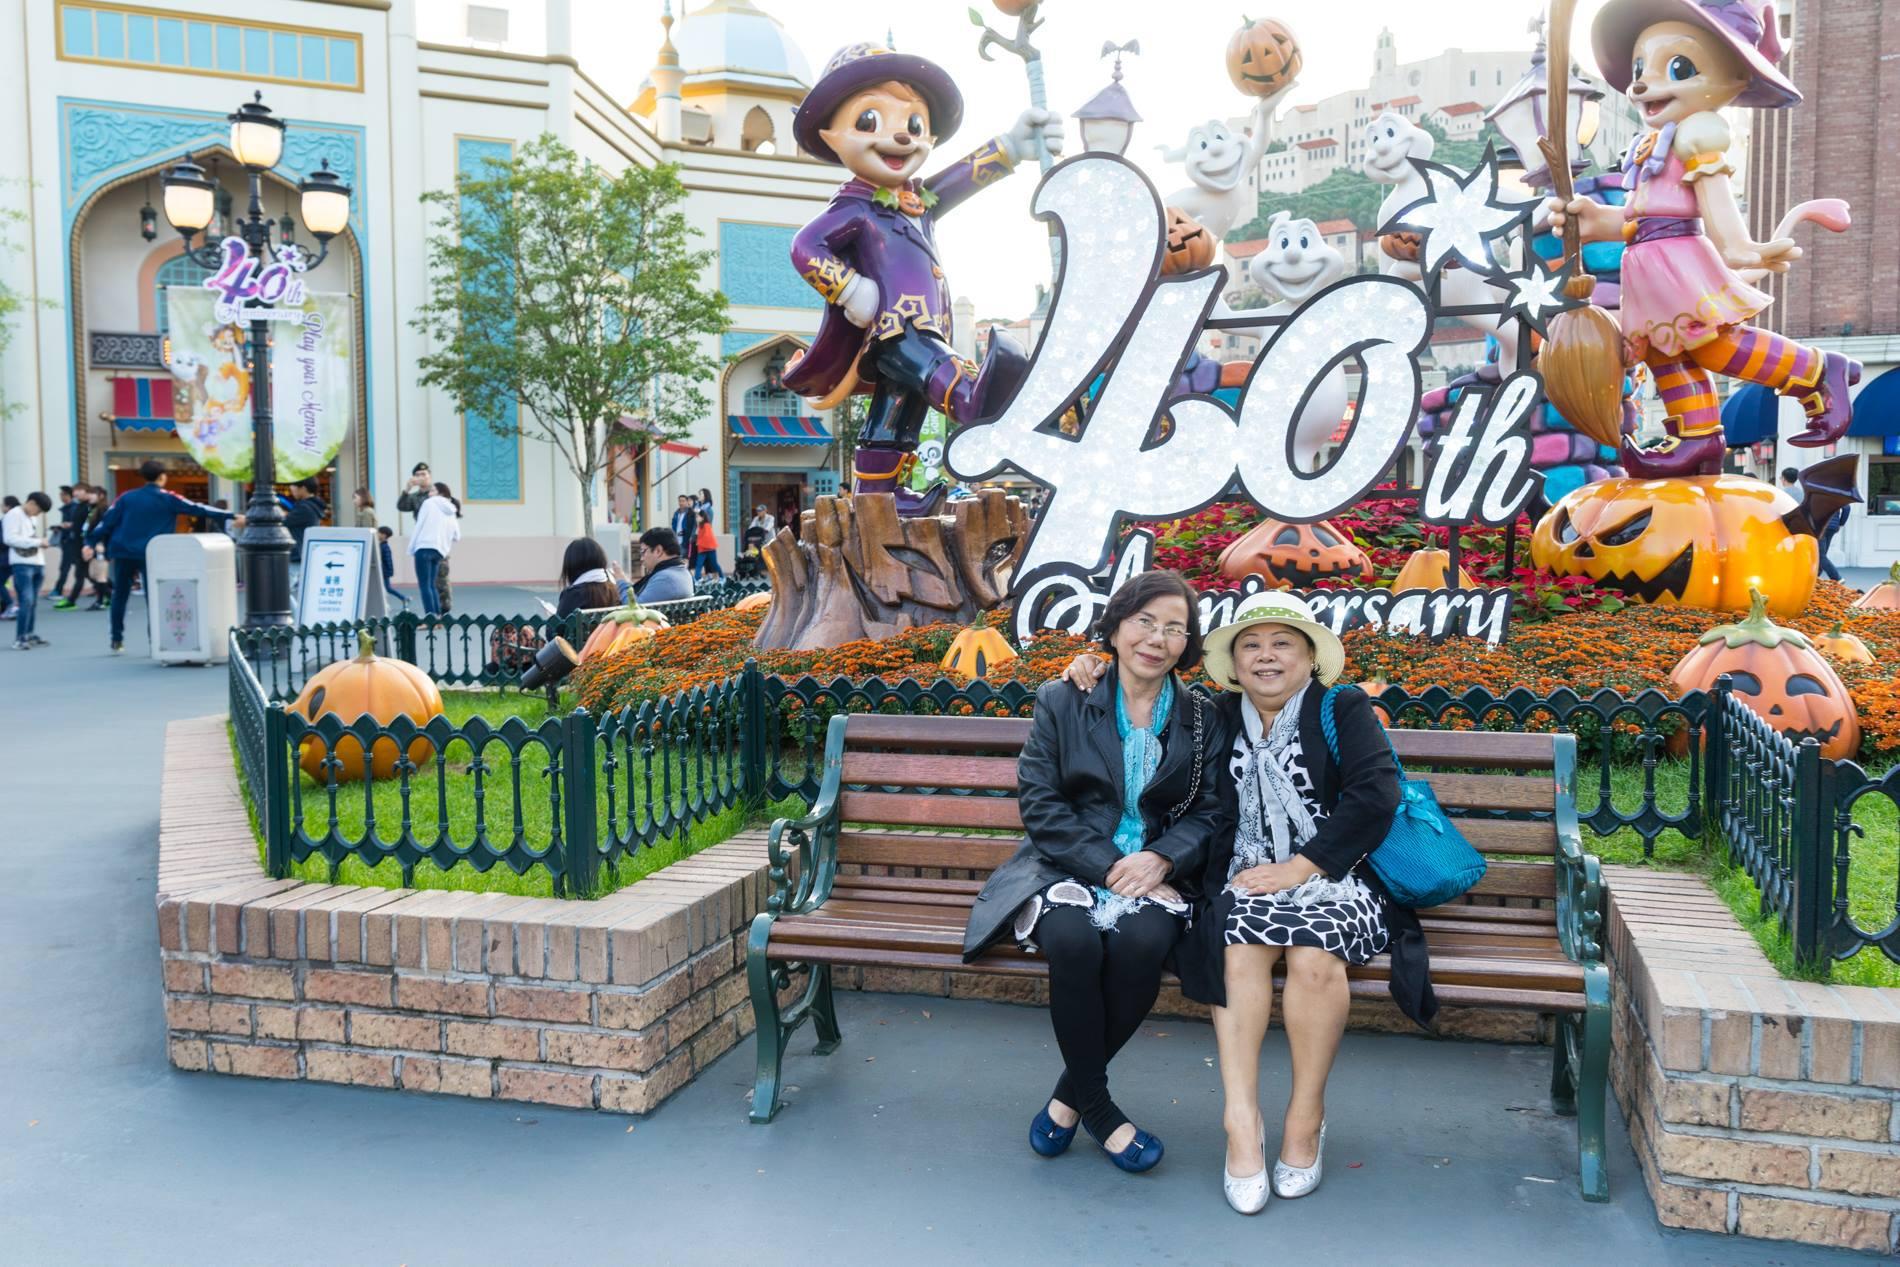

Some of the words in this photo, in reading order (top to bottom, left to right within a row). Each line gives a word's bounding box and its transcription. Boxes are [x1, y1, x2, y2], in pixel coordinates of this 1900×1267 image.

[296, 313, 325, 352] Play
[296, 357, 319, 385] your
[297, 390, 323, 456] Memory!
[1016, 532, 1509, 651] Anersary
